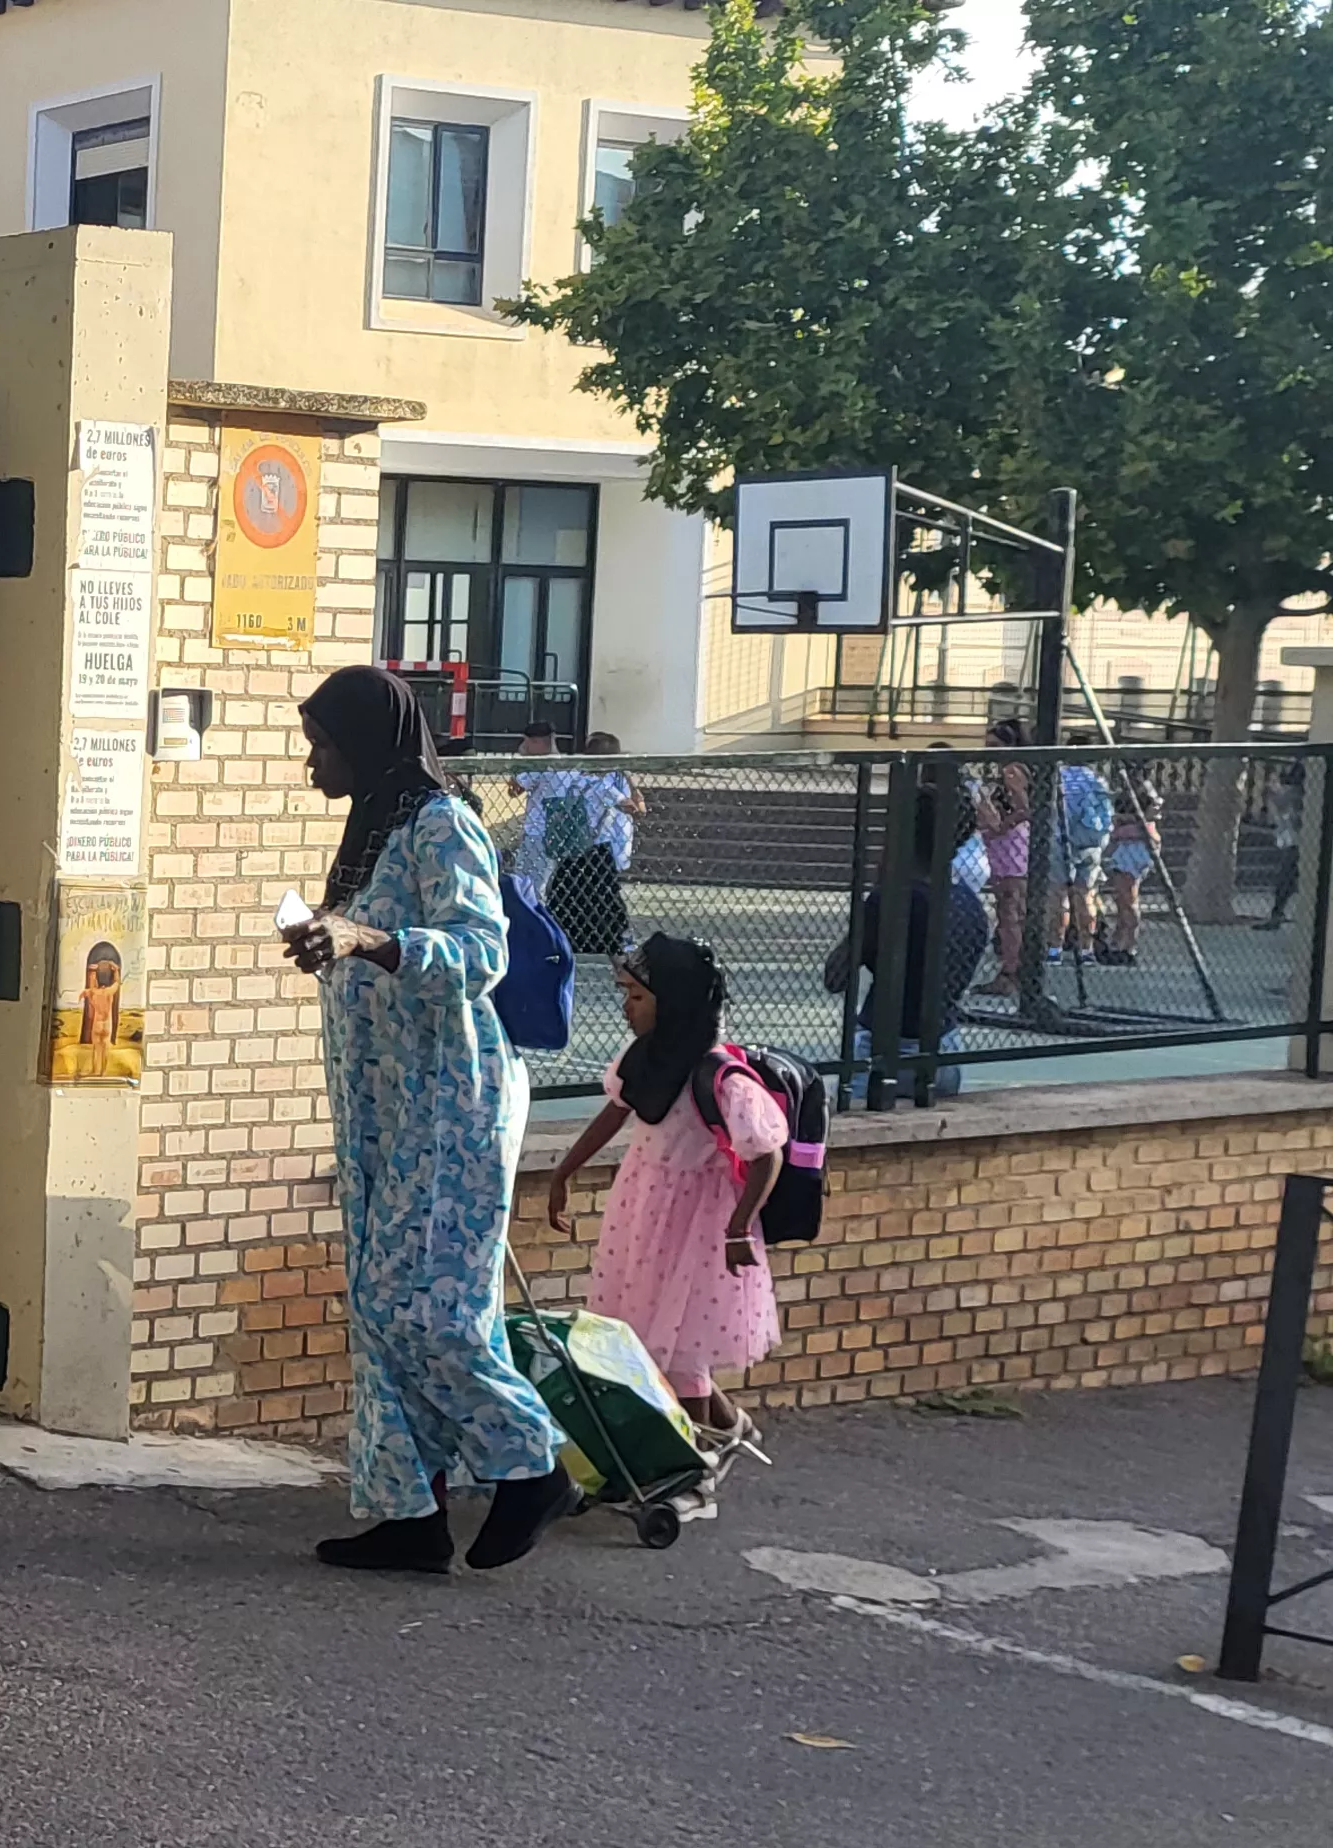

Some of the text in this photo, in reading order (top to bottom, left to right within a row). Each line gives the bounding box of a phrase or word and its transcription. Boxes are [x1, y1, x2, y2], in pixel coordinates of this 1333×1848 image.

[86, 429, 151, 447] 2,7 MILLONES
[86, 446, 127, 461] de euros
[80, 580, 133, 595] NO LLEVES
[79, 595, 142, 611] A TUS HIJOS
[79, 610, 120, 625] AL COLE
[236, 613, 307, 632] 1160 3 M
[84, 652, 133, 671] HUELGA
[79, 673, 87, 684] 19
[95, 673, 105, 685] 20
[90, 737, 137, 752] MILLONES
[86, 756, 113, 767] euros
[66, 850, 86, 862] PARA
[88, 851, 97, 862] LA
